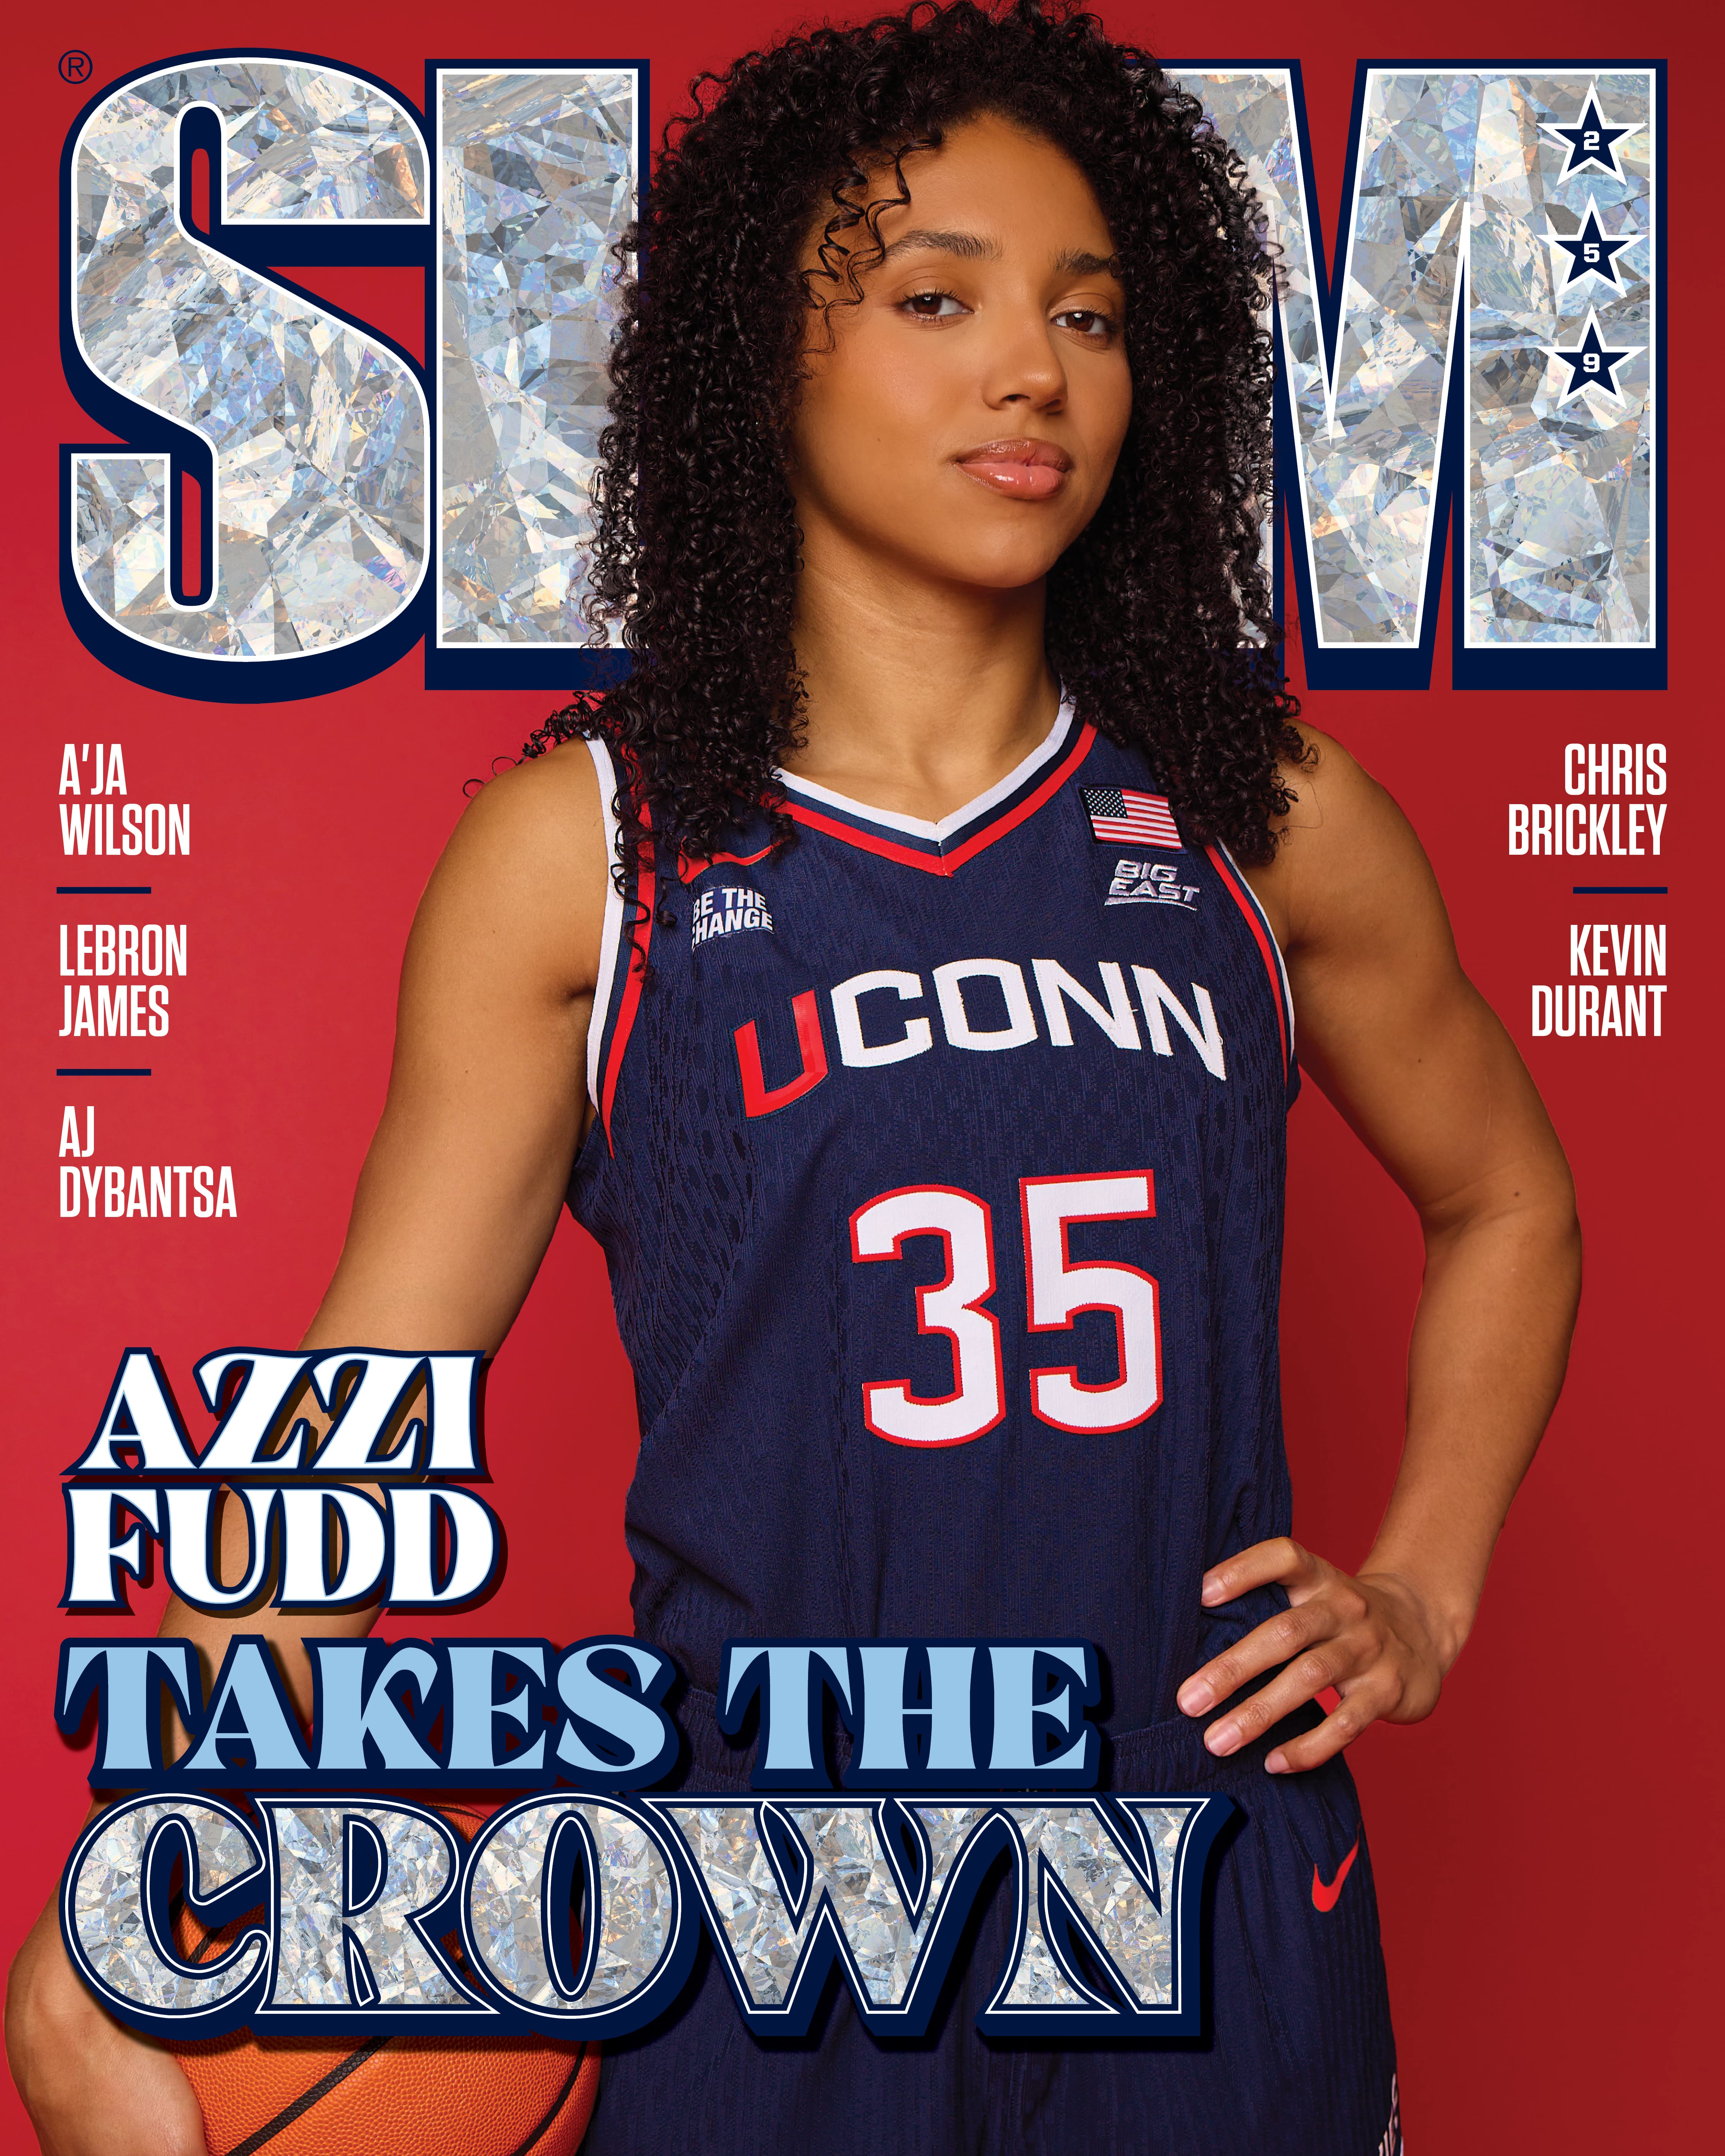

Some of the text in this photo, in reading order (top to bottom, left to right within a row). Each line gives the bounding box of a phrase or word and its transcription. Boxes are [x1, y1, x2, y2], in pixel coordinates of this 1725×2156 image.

[1115, 859, 1178, 882] BIG
[693, 888, 767, 923] BE THE
[1109, 877, 1200, 902] EAST
[692, 908, 773, 948] HANGE
[733, 958, 1227, 1120] UCONN
[849, 1169, 1163, 1448] 35
